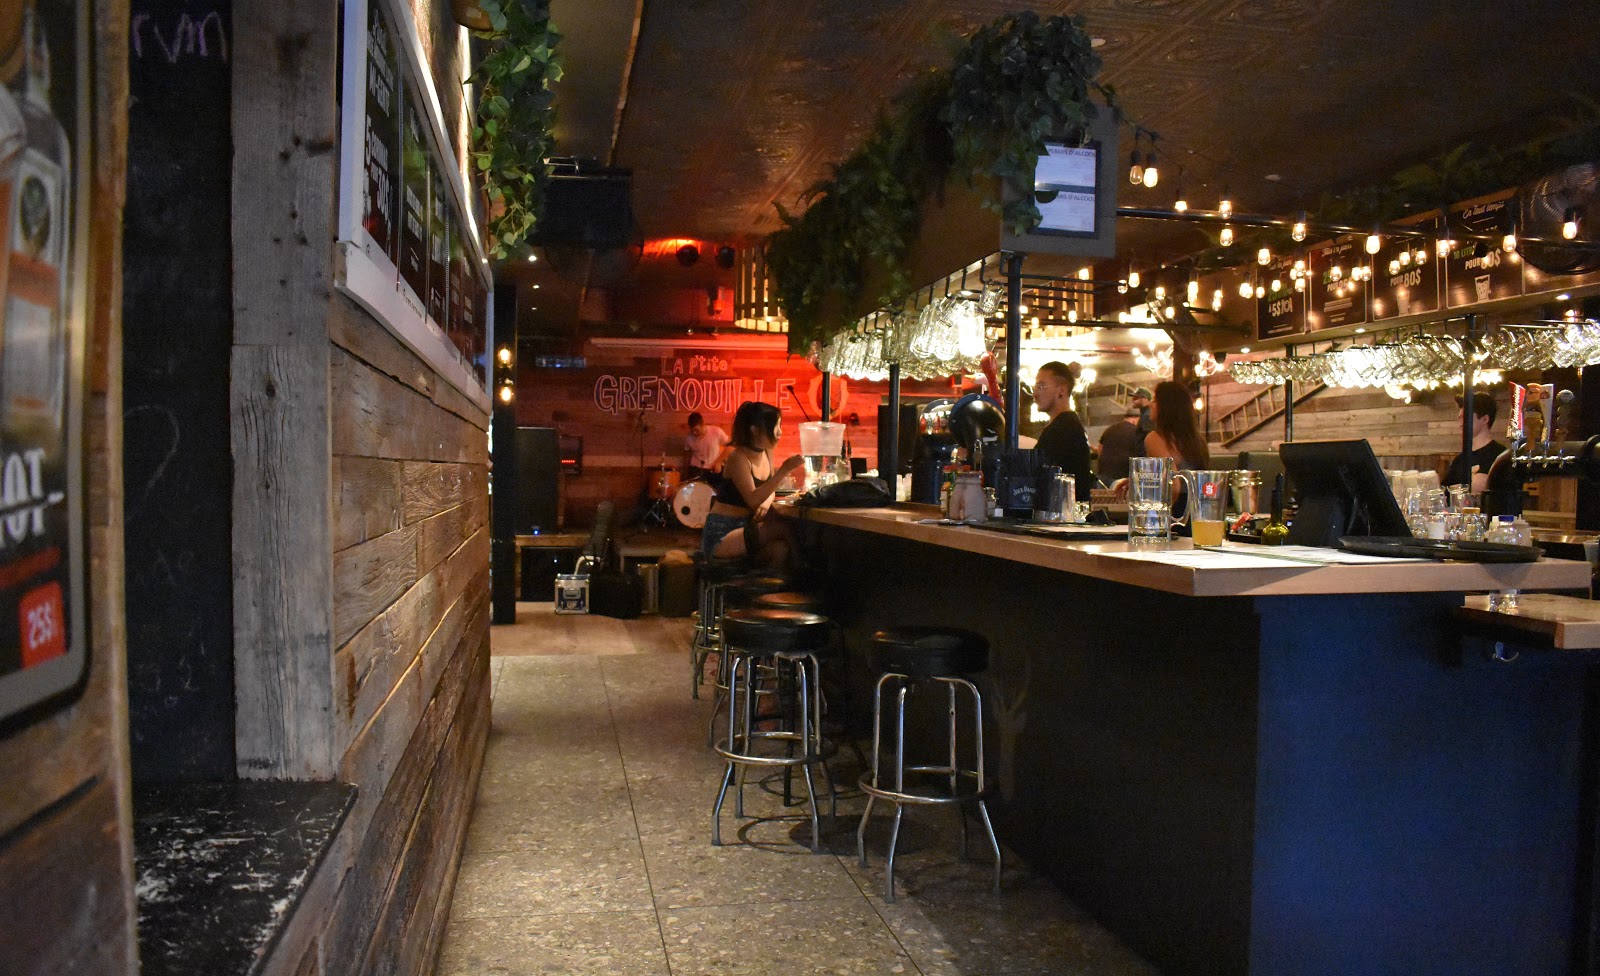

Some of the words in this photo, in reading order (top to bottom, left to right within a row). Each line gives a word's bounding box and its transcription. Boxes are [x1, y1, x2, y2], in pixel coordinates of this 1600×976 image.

[1465, 257, 1481, 270] POUR
[1390, 274, 1404, 287] POUR
[1404, 268, 1421, 287] 80$
[661, 356, 683, 375] LA
